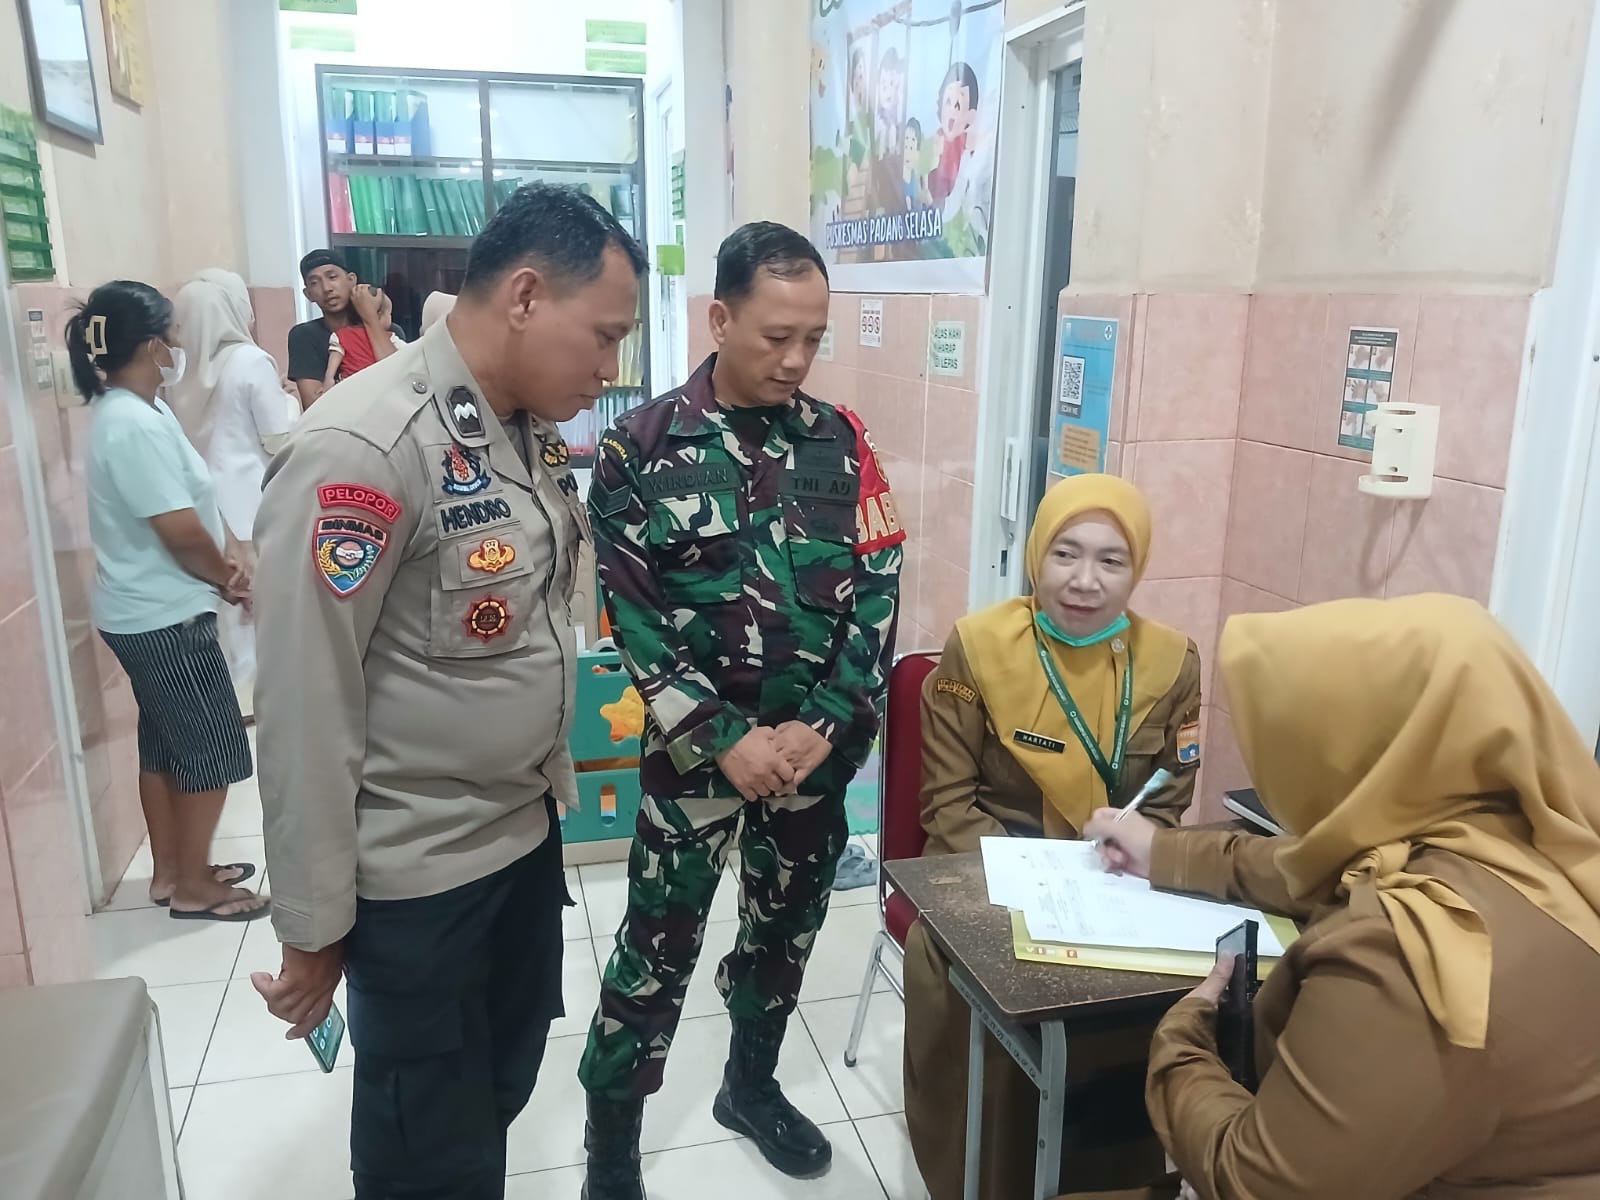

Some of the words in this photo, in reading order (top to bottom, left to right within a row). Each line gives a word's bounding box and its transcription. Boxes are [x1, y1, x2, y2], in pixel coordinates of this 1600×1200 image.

[869, 214, 903, 243] PADANG
[905, 207, 942, 239] SELASA
[325, 488, 396, 517] PELOPOR
[792, 477, 820, 493] TNI
[829, 480, 850, 496] AD
[440, 497, 512, 533] HENDRO
